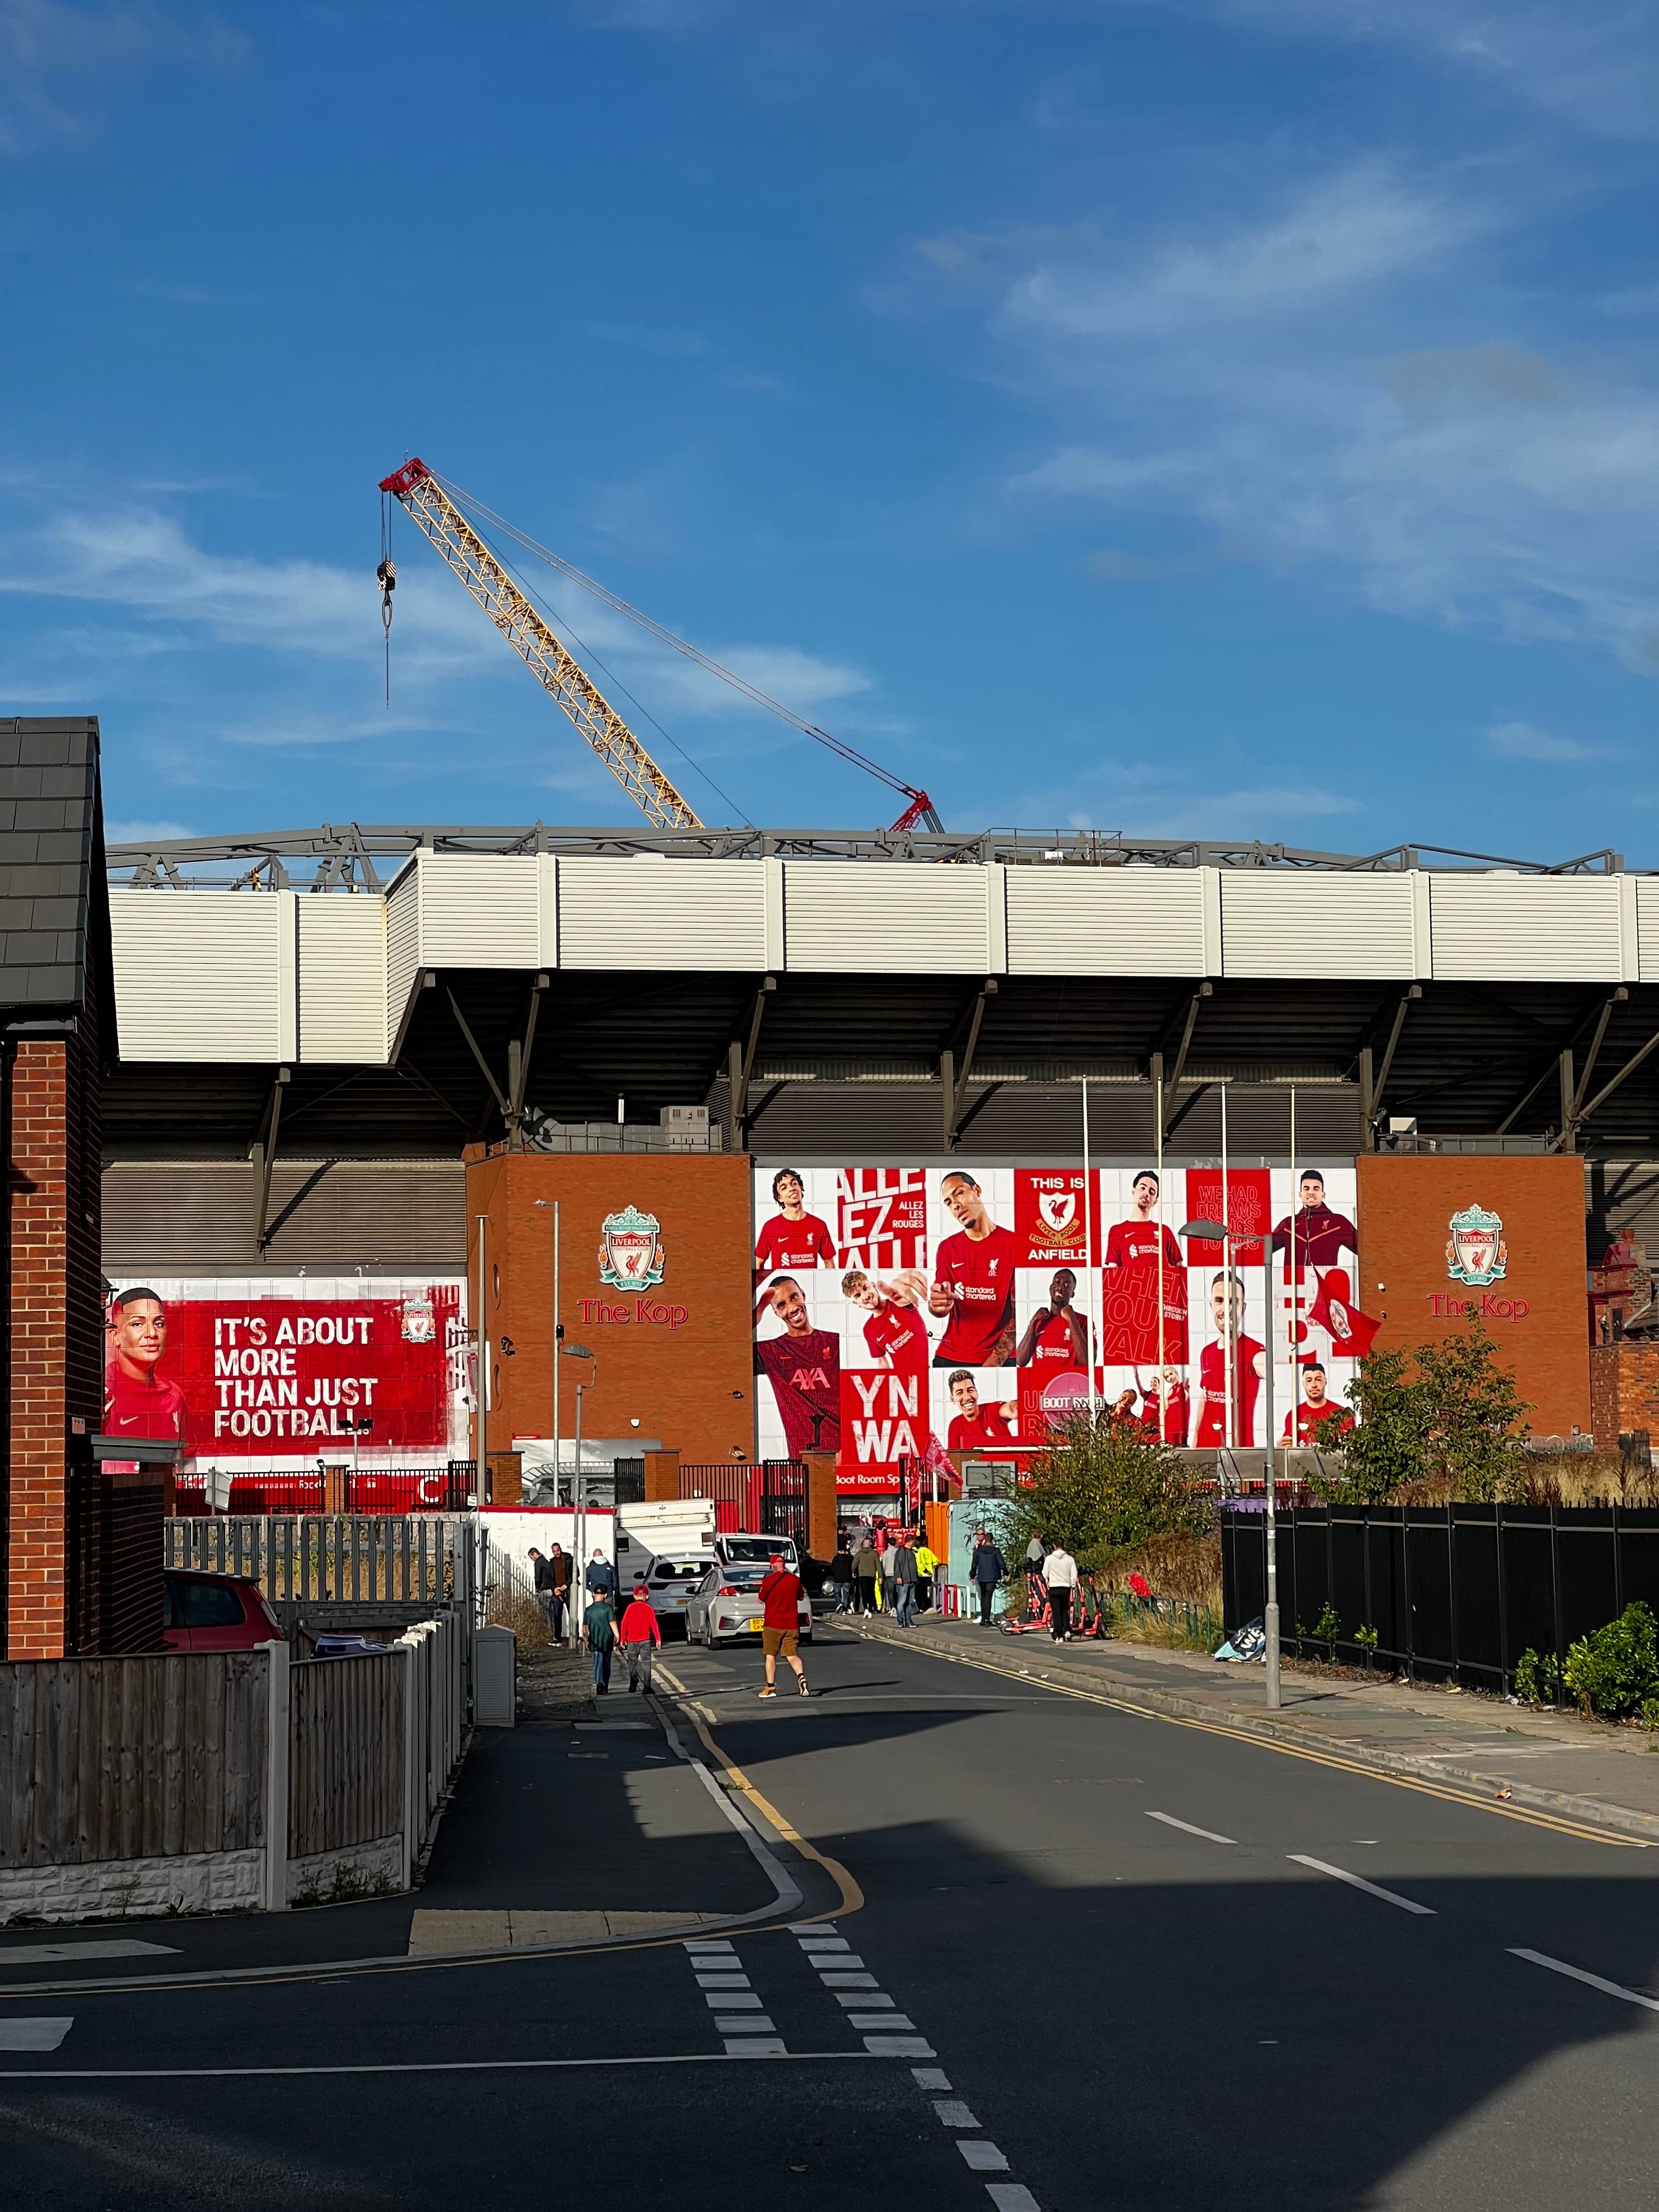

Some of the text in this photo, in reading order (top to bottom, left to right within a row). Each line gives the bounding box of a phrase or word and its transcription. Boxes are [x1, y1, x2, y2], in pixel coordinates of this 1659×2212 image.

[1030, 1177, 1085, 1189] THIS IS
[1199, 1186, 1257, 1203] WE HAD
[899, 1201, 923, 1210] ALLEZ
[1197, 1201, 1261, 1218] DREAMS
[842, 1197, 894, 1249] EZ
[909, 1210, 924, 1219] LES
[892, 1220, 924, 1228] ROUGES
[1039, 1222, 1077, 1238] LIVER POOL
[1030, 1234, 1086, 1246] FOOTBALL CLUB
[1028, 1249, 1087, 1260] ANFIELD
[577, 1299, 689, 1330] The Kop
[1164, 1311, 1184, 1322] STORM
[1427, 1293, 1530, 1323] The Kop
[215, 1317, 374, 1346] IT'S ABOUT
[215, 1348, 296, 1376] MORE
[789, 1367, 831, 1390] AXA
[215, 1378, 378, 1408] THAN JUST
[850, 1374, 918, 1418] YN
[1043, 1397, 1070, 1408] BOOT
[851, 1420, 920, 1463] WA
[857, 1474, 885, 1484] Room
